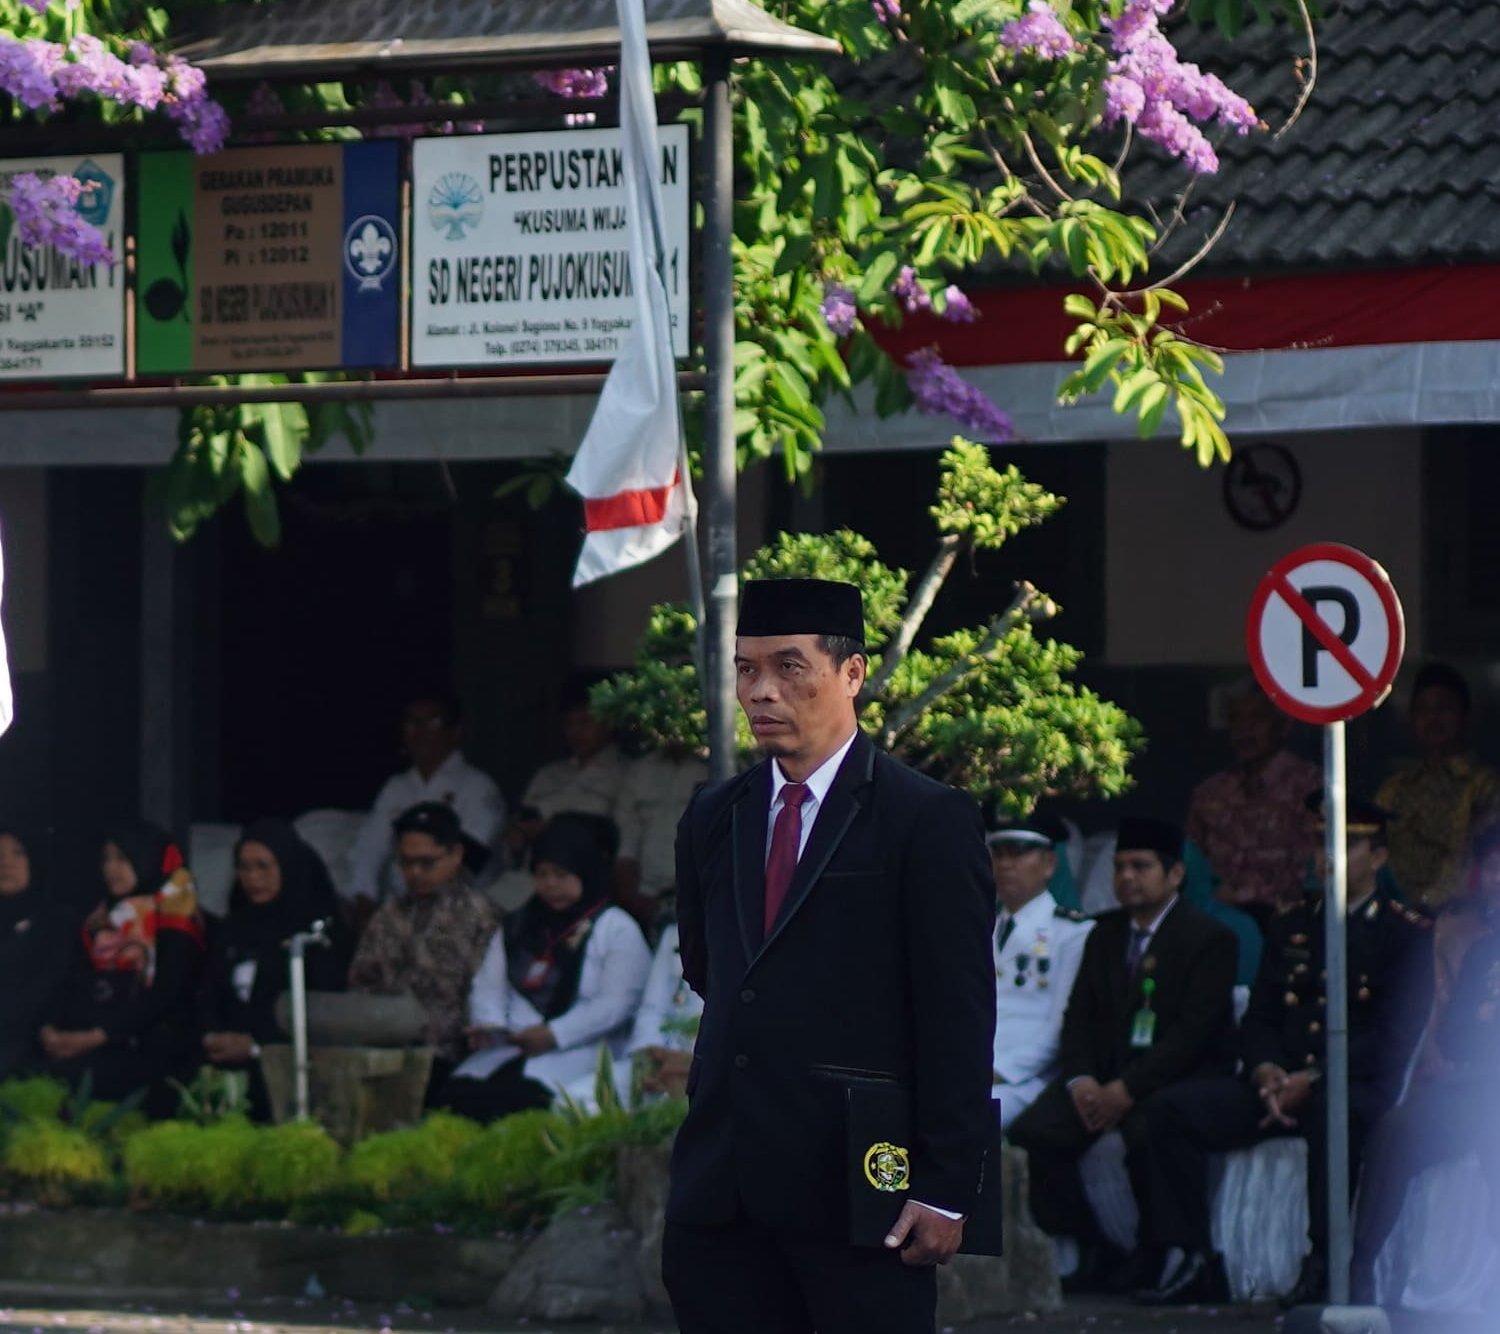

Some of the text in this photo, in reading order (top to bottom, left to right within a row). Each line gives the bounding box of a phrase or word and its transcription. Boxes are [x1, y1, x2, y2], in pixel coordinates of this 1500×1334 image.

[201, 166, 334, 190] GERAKAN PRAMUKA
[489, 145, 677, 192] PERPUSTAKN
[221, 193, 312, 214] GUGUSDEPAN
[261, 221, 307, 238] 12011
[261, 246, 308, 263] 12012
[429, 258, 450, 304] SD
[456, 255, 522, 303] NEGERI
[671, 247, 679, 296] 1
[1301, 586, 1360, 688] P
